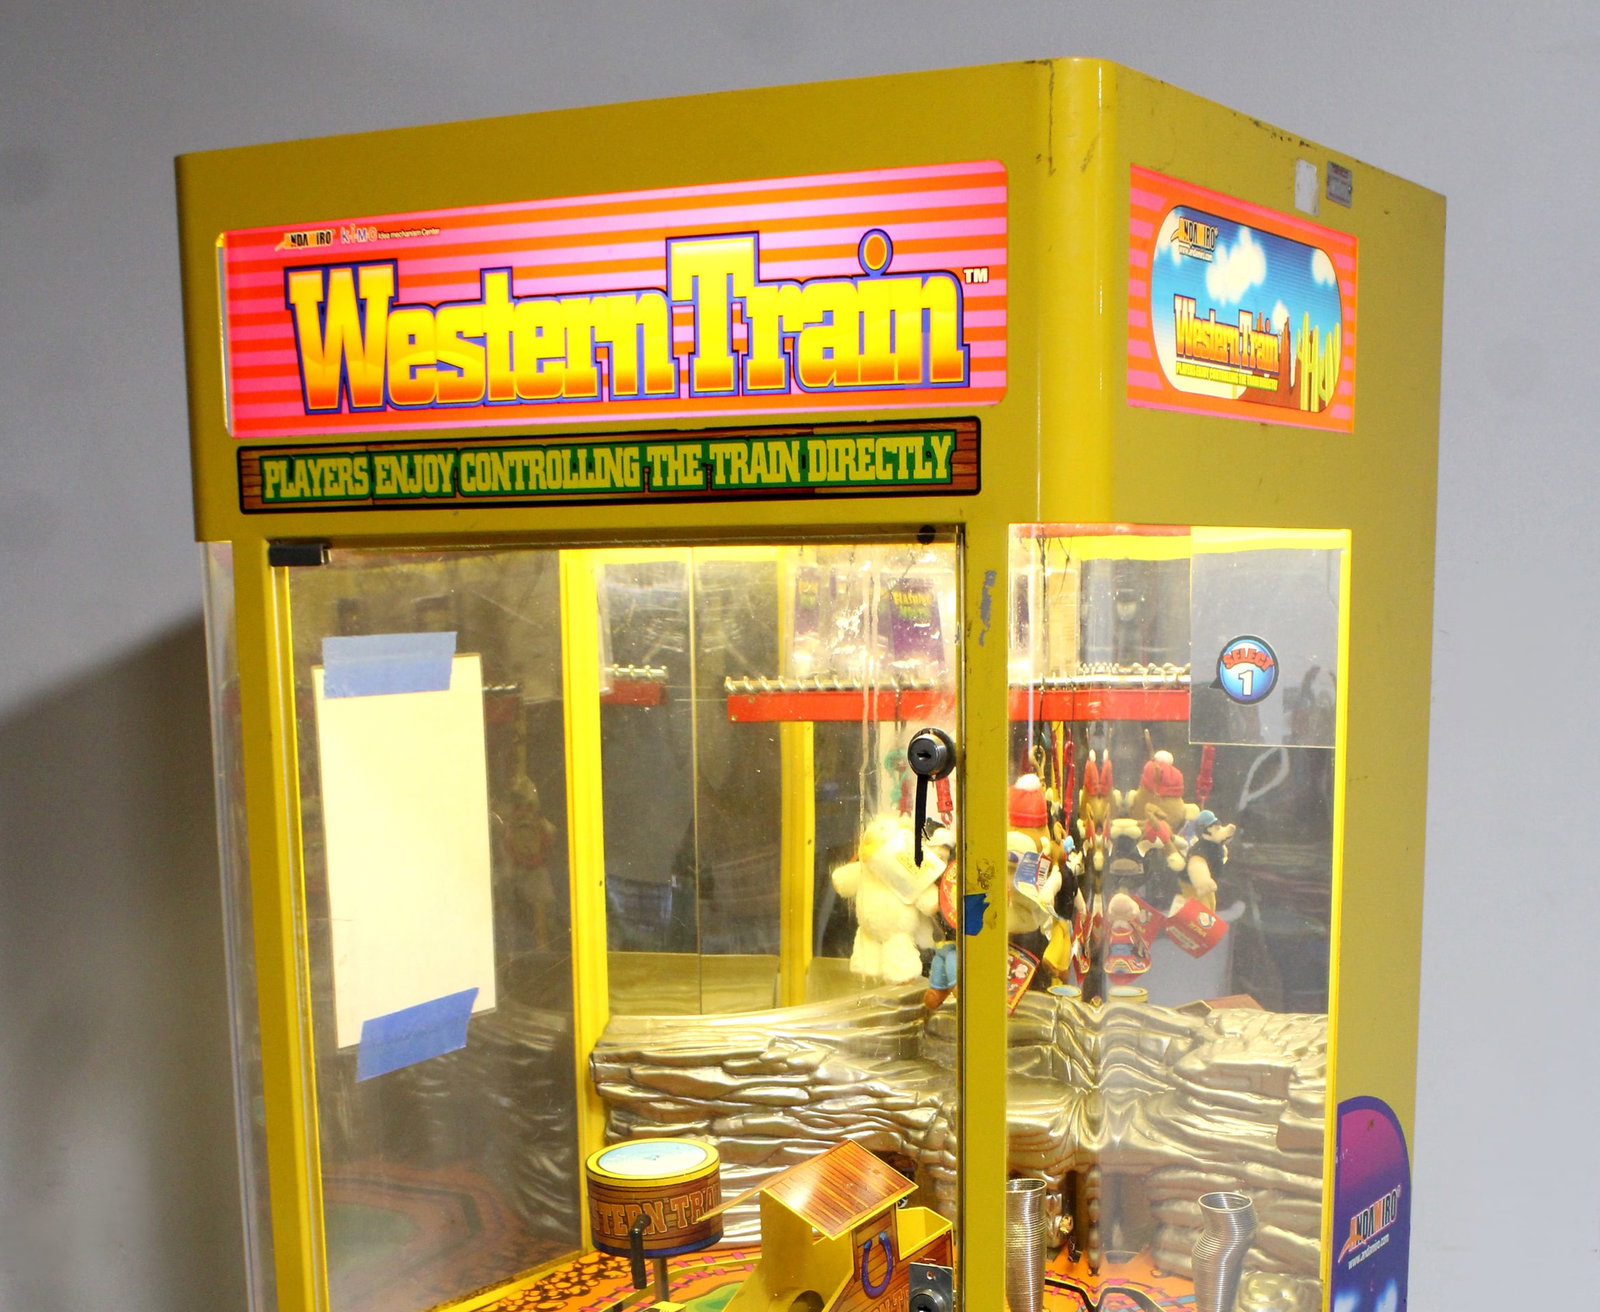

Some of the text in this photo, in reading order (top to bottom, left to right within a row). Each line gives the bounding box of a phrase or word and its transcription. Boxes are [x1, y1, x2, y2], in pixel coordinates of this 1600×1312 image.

[264, 435, 952, 499] PLAYERS ENJOY CONTROLLING THE TRAIN DIRECTLY
[1222, 647, 1275, 673] SELECT
[1238, 669, 1254, 697] 1
